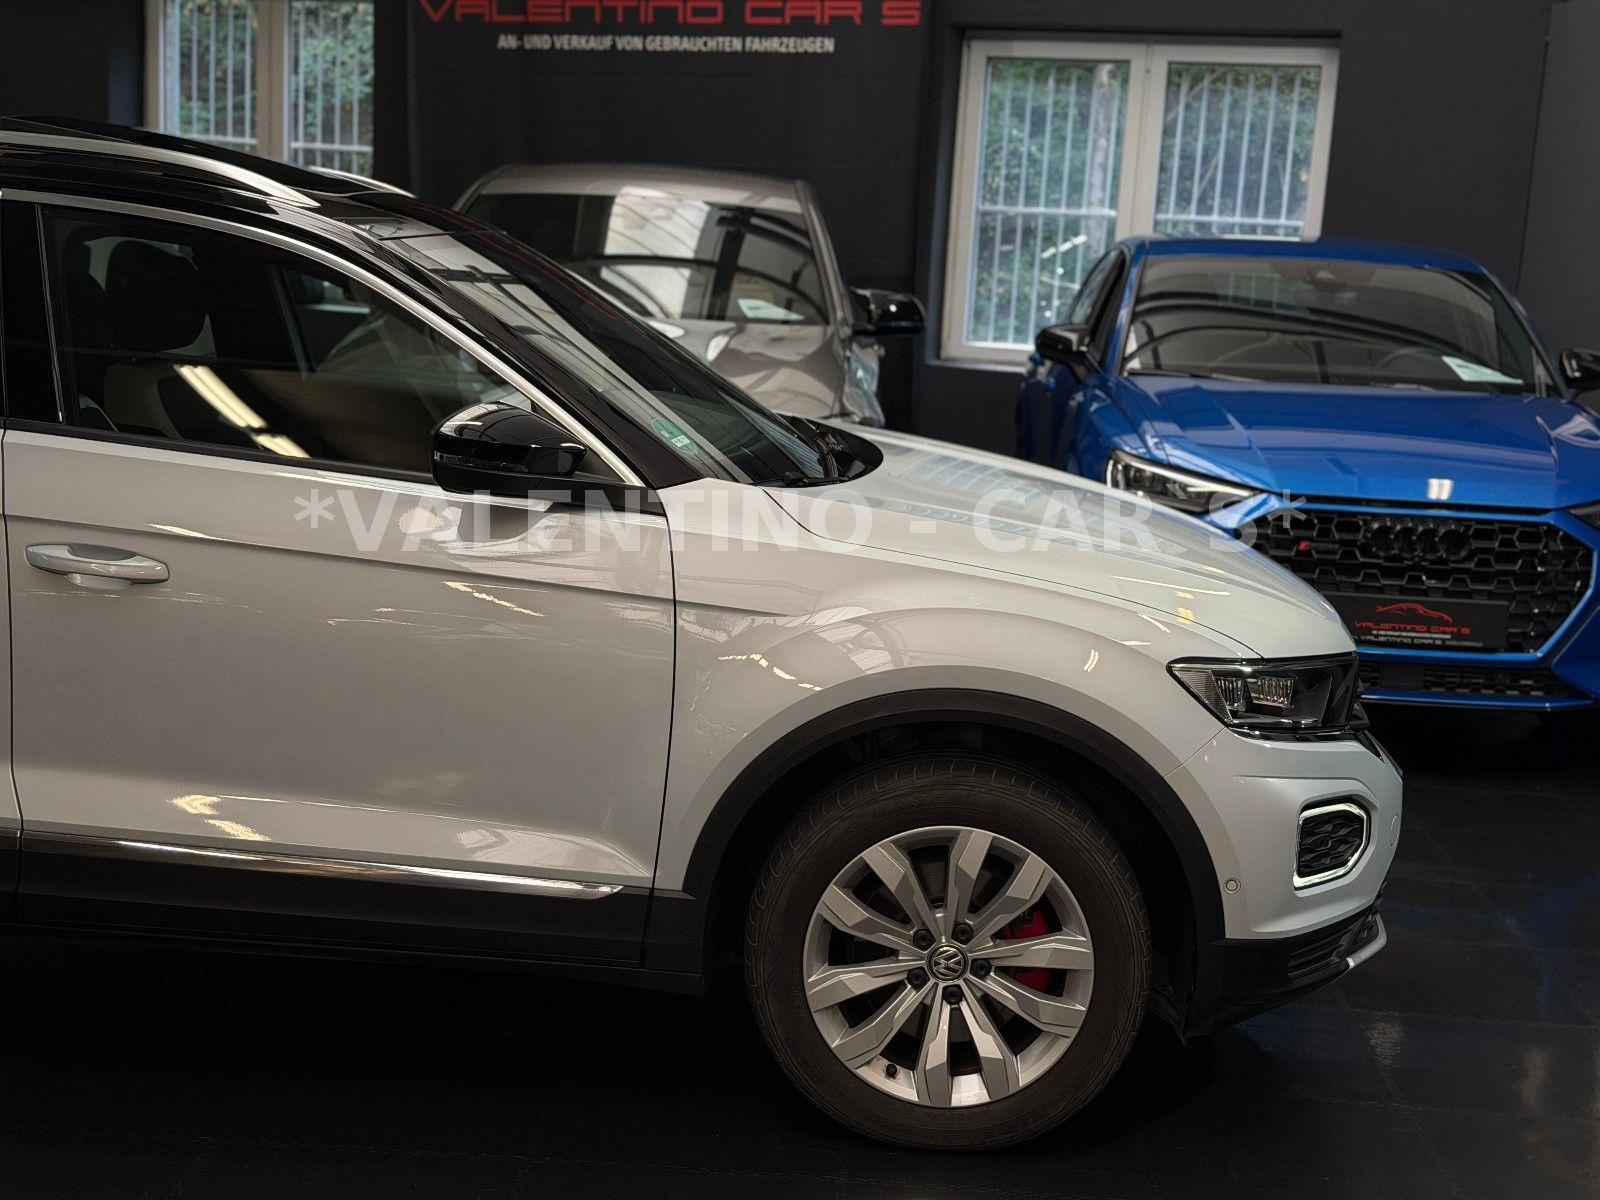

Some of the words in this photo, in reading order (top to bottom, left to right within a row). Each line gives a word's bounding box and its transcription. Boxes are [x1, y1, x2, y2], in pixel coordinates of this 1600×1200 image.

[420, 0, 725, 24] VALENTINO
[497, 34, 522, 49] AN-
[523, 34, 551, 50] UND
[552, 34, 614, 50] VERKAUF
[614, 35, 644, 50] VON
[645, 35, 743, 52] GEBRAUCHTEN
[744, 36, 836, 53] FAHRZEUGEN
[1354, 621, 1428, 631] VALENTINO
